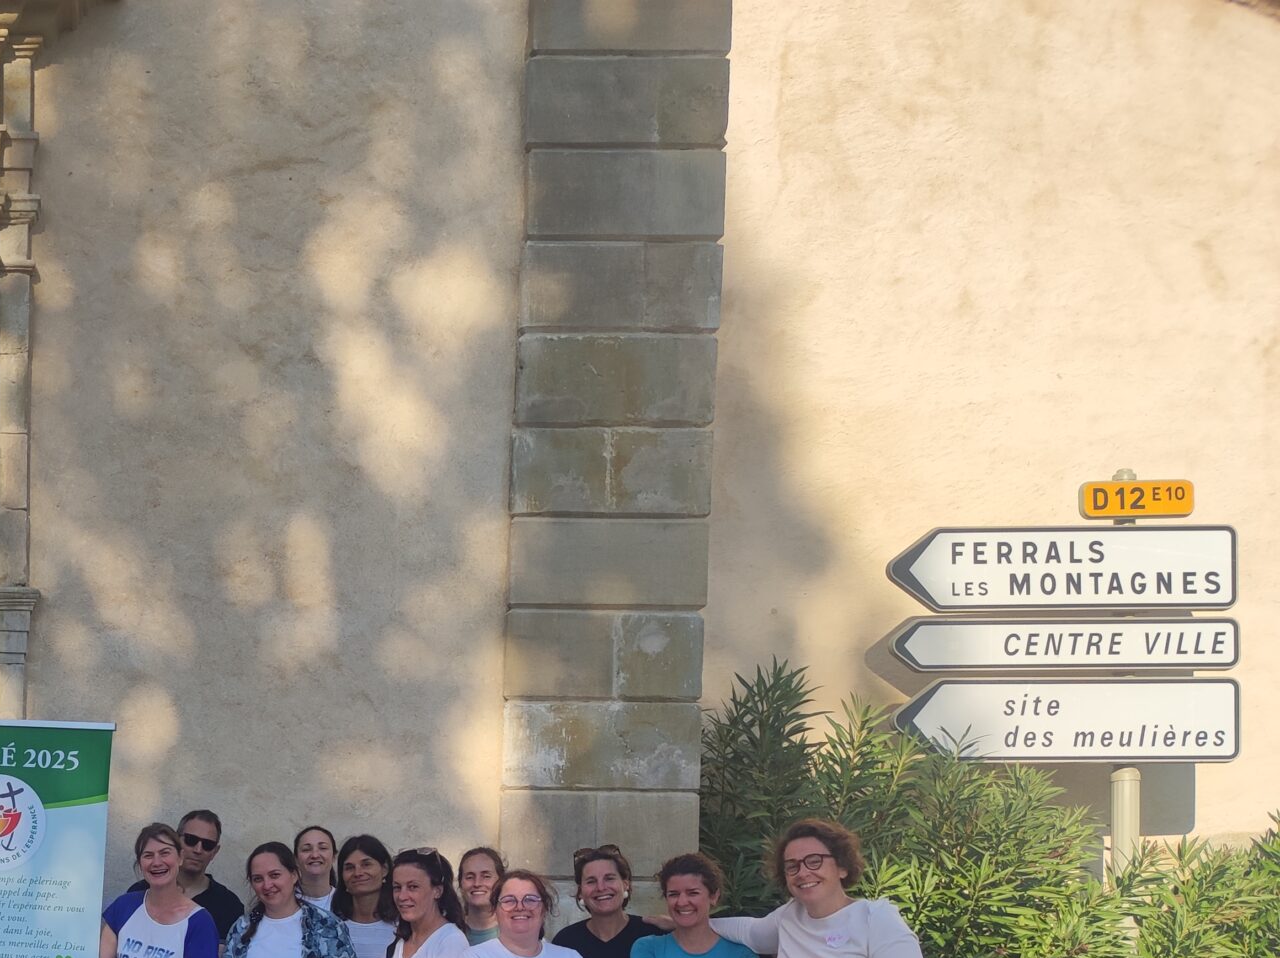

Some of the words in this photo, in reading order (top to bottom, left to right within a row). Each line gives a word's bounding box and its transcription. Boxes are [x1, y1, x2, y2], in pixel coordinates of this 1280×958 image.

[951, 540, 1105, 564] FERRALS
[951, 582, 989, 596] LES
[1009, 571, 1222, 596] MONTAGNES
[1003, 632, 1124, 656] CENTRE
[1144, 631, 1226, 656] VILLE
[1003, 693, 1060, 716] site
[1004, 725, 1054, 748] des
[1073, 724, 1226, 748] meulières
[22, 748, 80, 771] 2025
[11, 853, 22, 861] DE
[17, 874, 27, 883] de
[28, 876, 72, 889] pèlerinage
[22, 888, 33, 897] du
[35, 891, 57, 901] pape.
[8, 899, 52, 912] l'espérance
[3, 925, 22, 935] dans
[25, 926, 33, 935] la
[8, 939, 49, 950] merveilles
[52, 941, 62, 950] de
[64, 941, 85, 951] Dieu
[123, 938, 143, 953] NO
